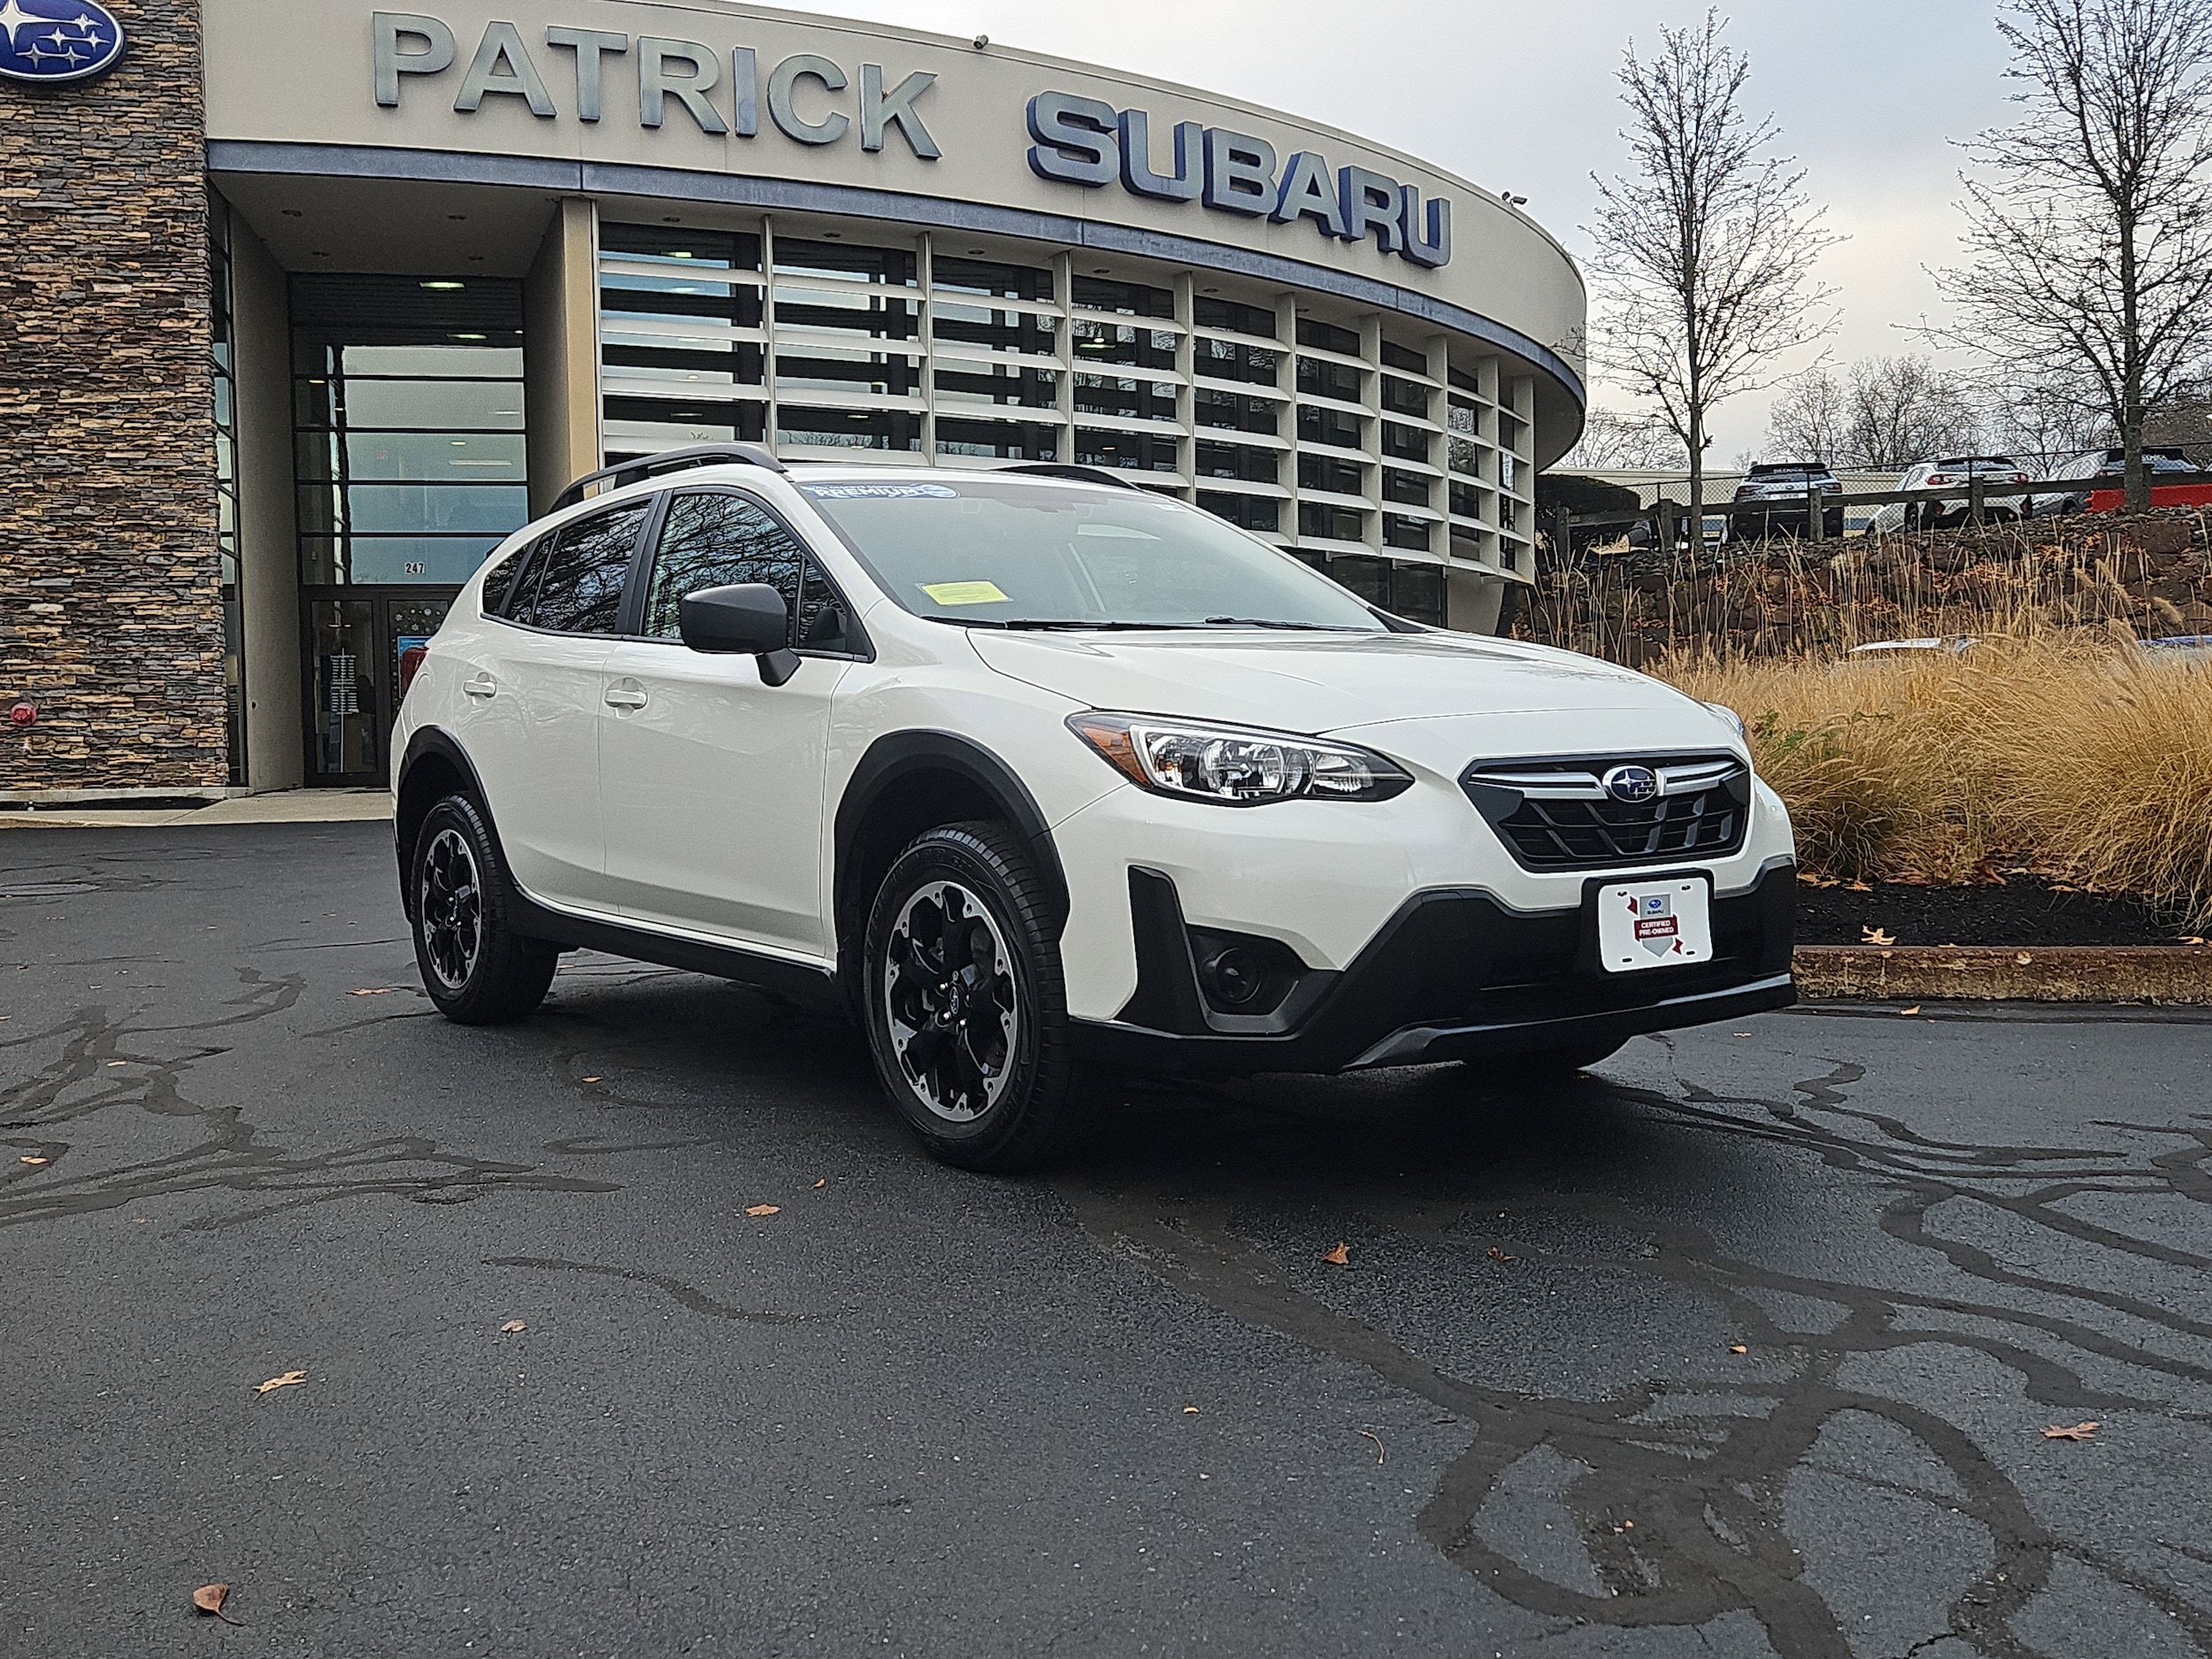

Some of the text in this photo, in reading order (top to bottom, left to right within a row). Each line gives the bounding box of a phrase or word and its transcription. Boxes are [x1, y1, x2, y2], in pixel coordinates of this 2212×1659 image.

[373, 11, 1452, 268] PATRICK SUBARU
[405, 563, 424, 573] 247
[1639, 926, 1674, 936] PRE-OWNED
